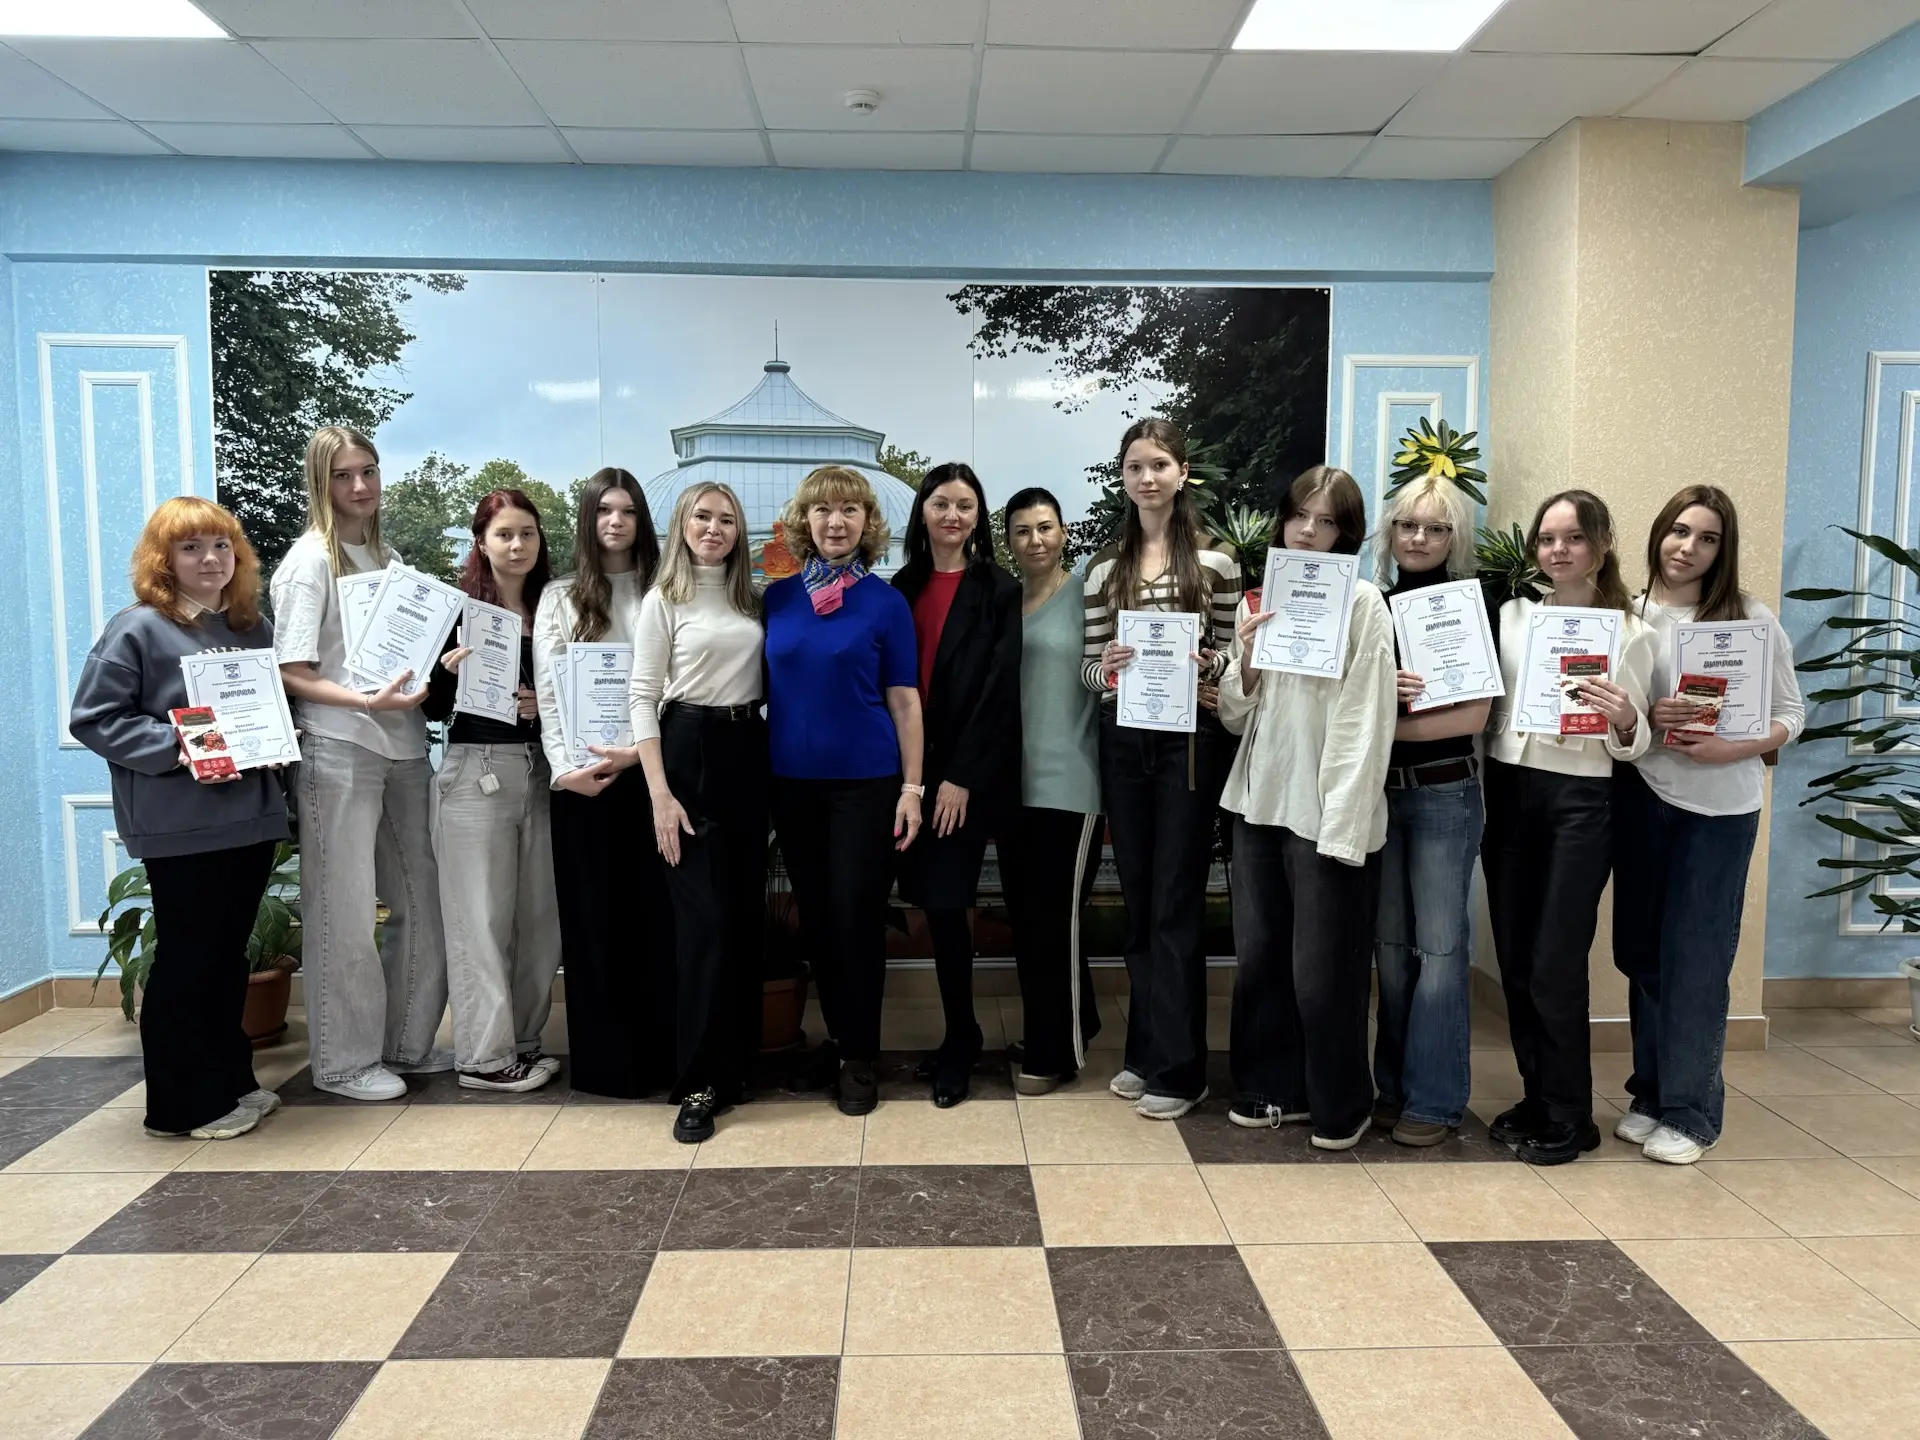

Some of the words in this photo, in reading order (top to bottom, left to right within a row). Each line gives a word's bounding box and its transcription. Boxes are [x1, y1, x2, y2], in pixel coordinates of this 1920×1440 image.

[1291, 589, 1327, 600] ДИПЛОМ
[1425, 618, 1461, 632] ДИПЛОМ
[1550, 645, 1588, 655] ДИПЛОМ
[1703, 659, 1743, 669] ДИПЛОМ
